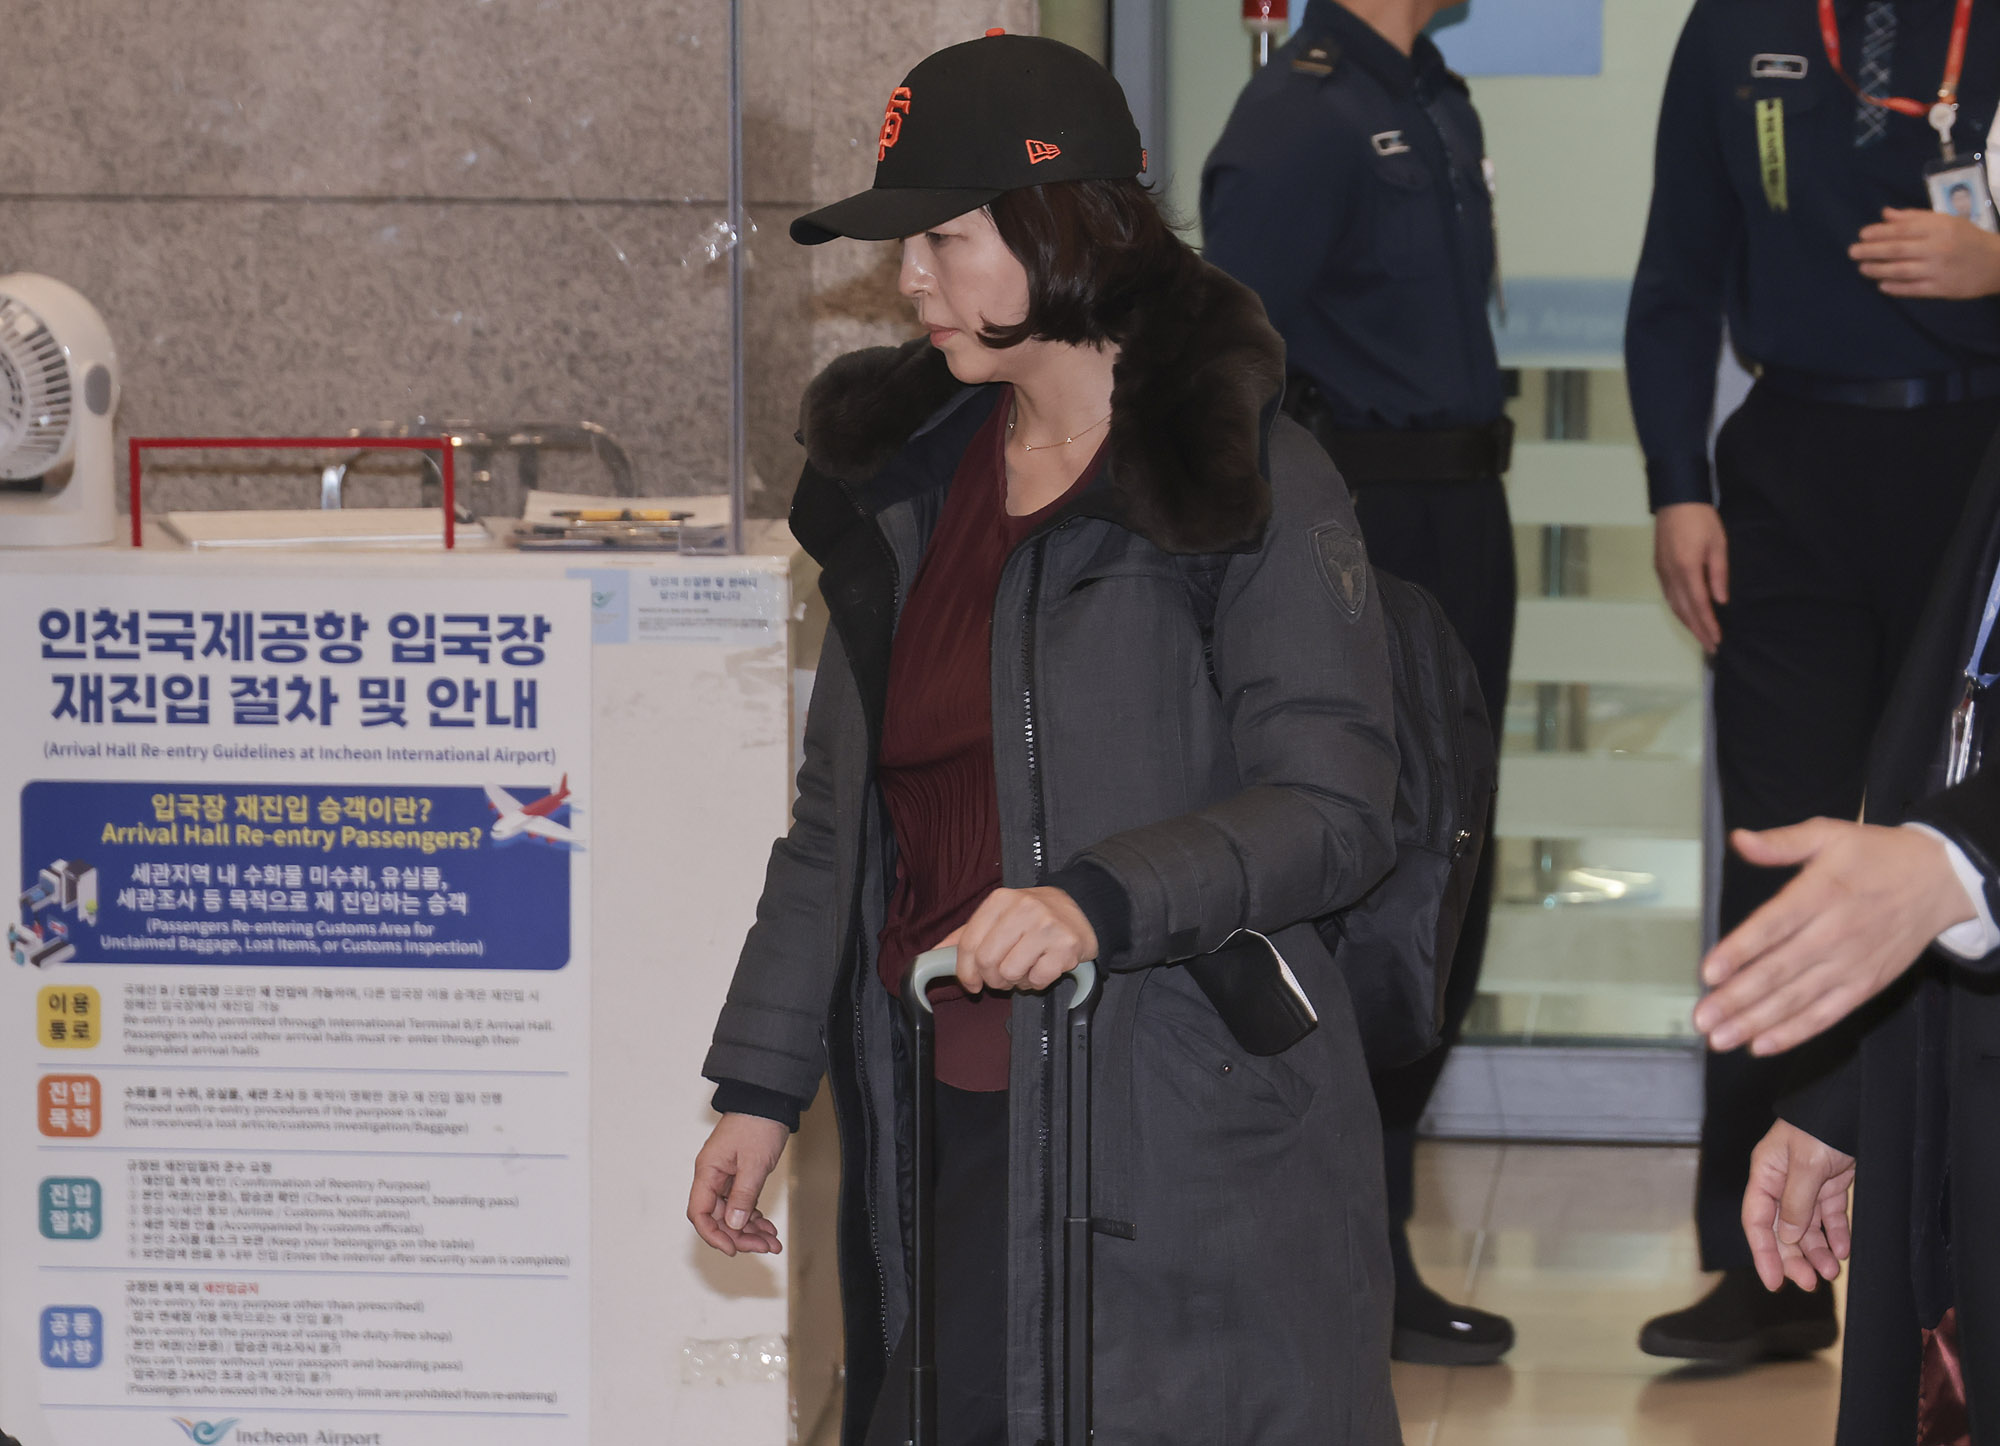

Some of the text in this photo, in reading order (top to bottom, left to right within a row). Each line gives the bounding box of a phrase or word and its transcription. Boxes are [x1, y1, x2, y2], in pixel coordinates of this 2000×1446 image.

[39, 607, 552, 666] 인천국제공항 입국장
[51, 672, 537, 728] 재진입 절차 및 안내
[43, 741, 556, 766] (Arrival Hall Re-entry Guidelines at Incheon International Airport)
[151, 793, 432, 825] 입국장 재진입 승객이란?
[102, 822, 482, 854] Arrival Hall Re-entry Passengers?
[131, 862, 449, 891] 세관지역 내 수화물 미수취, 유실물,
[116, 887, 468, 916] 세관조사 등 목적으로 재 진입하는 승객
[147, 917, 435, 939] (Passengers Re-entering Customs Area for
[100, 935, 484, 957] Unclaimed Baggage, Lost Items, or Customs Inspection)
[49, 993, 89, 1015] 이용
[49, 1081, 91, 1105] 진입
[49, 1108, 91, 1132] 목적
[50, 1183, 92, 1208] 진입
[50, 1210, 94, 1234] 절차
[50, 1312, 94, 1337] 공통
[50, 1339, 94, 1363] 사항
[236, 1428, 381, 1446] Incheon Airport
